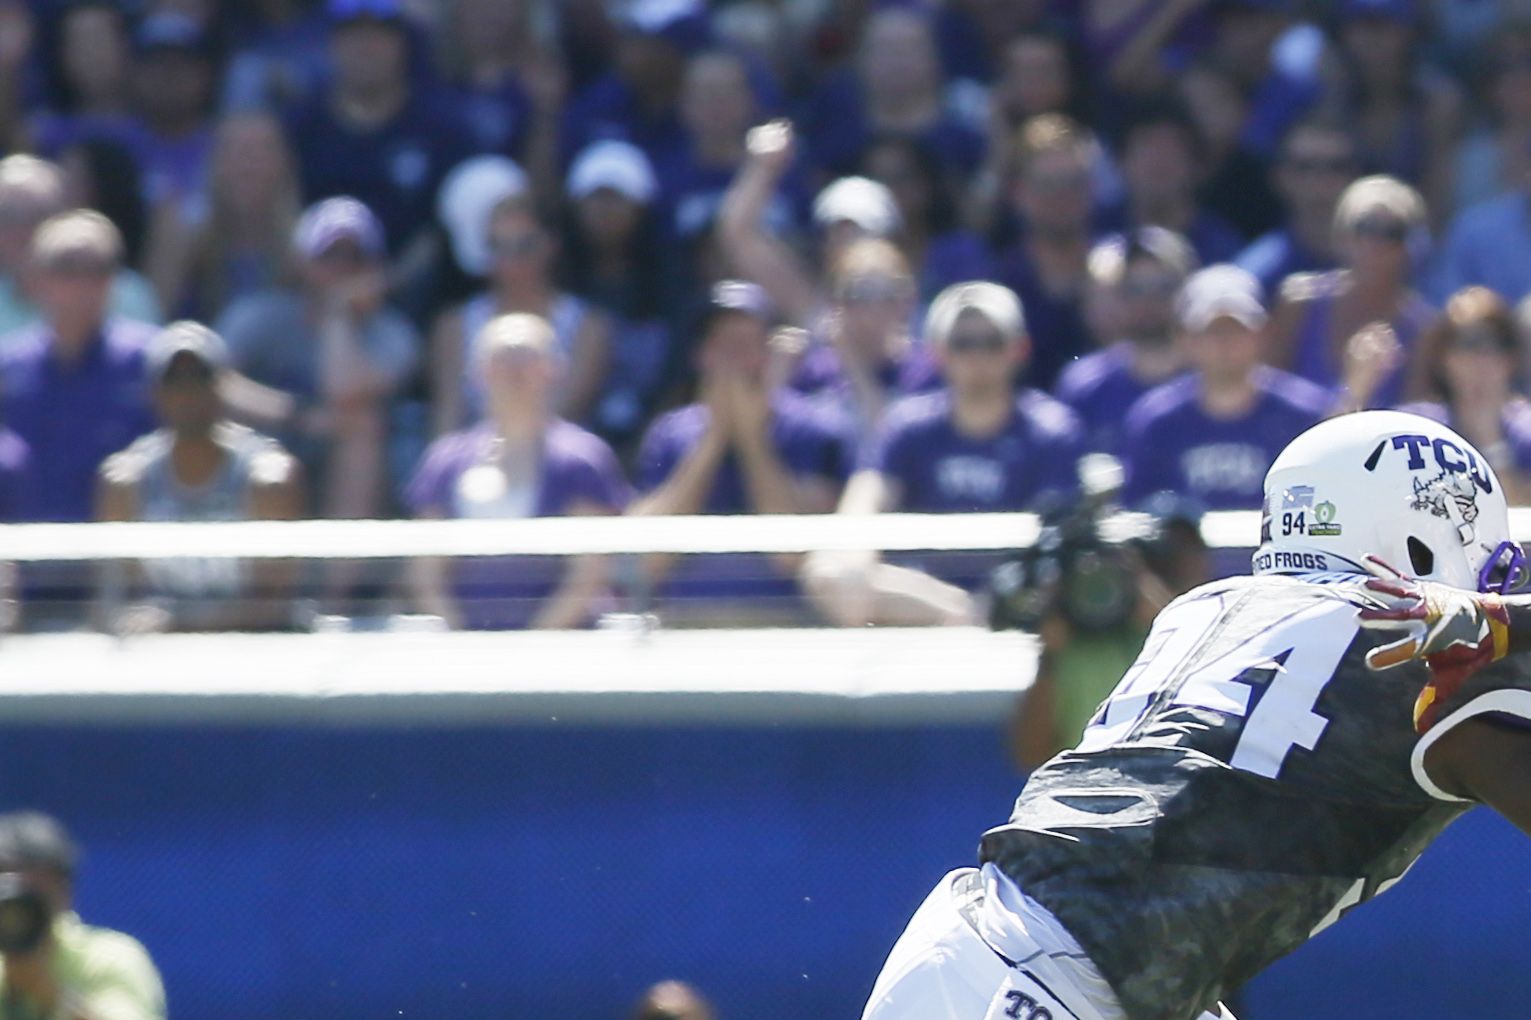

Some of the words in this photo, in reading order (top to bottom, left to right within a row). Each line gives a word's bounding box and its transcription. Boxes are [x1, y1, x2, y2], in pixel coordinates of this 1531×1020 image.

[1391, 434, 1493, 494] TCU
[1282, 511, 1306, 536] 94
[1275, 552, 1328, 571] FROGS
